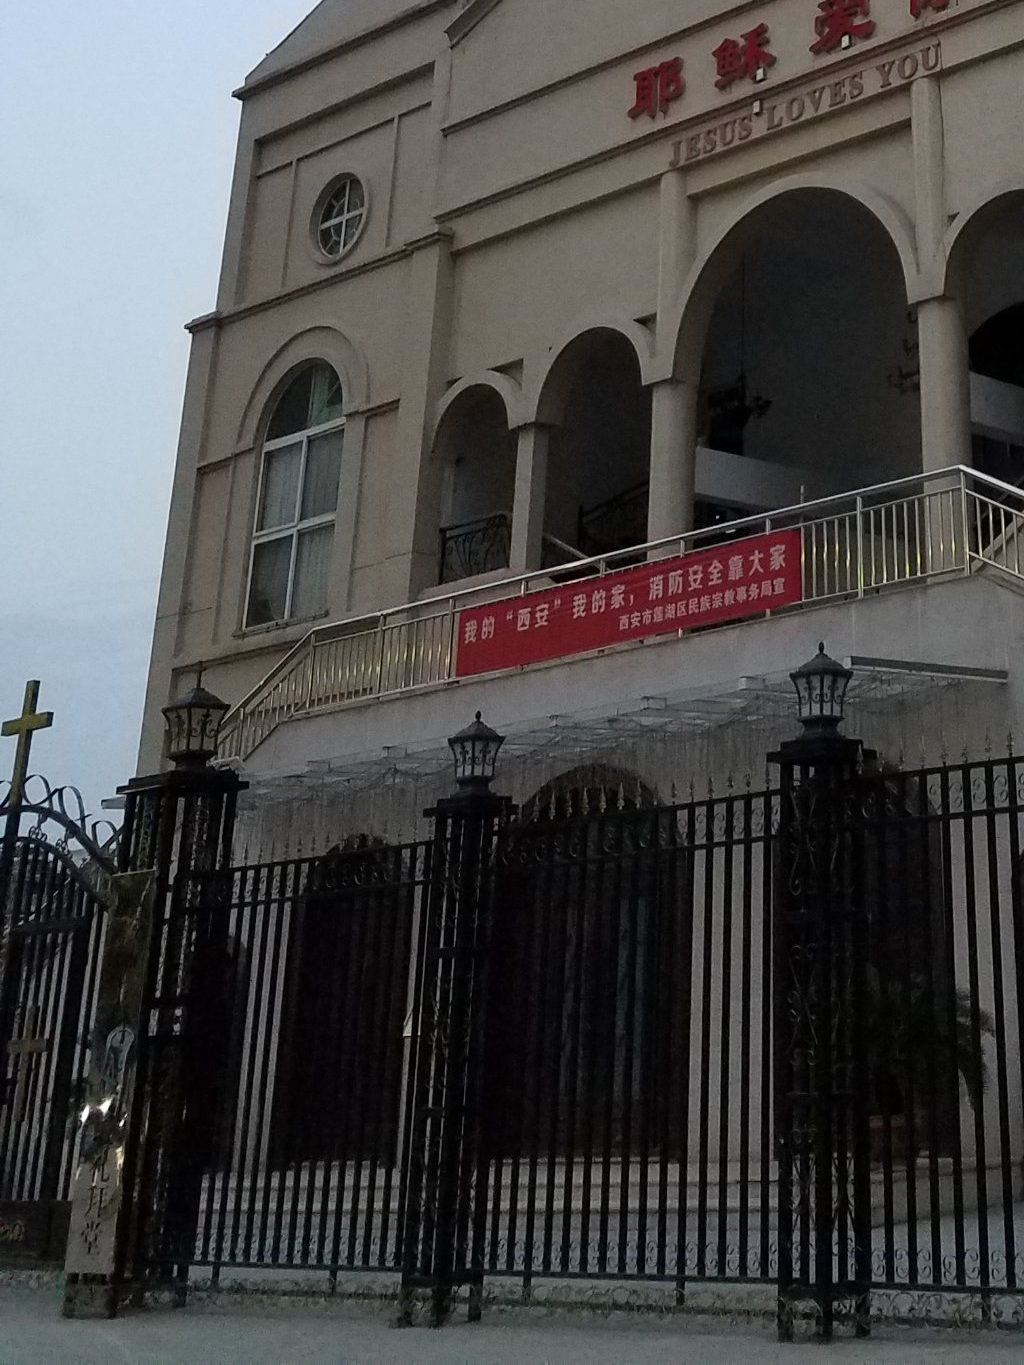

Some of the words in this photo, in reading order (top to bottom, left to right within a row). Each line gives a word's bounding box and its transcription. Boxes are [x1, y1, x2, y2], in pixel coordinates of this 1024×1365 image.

[669, 116, 753, 167] JESUS
[766, 71, 863, 131] LOVES
[875, 44, 940, 88] YOU
